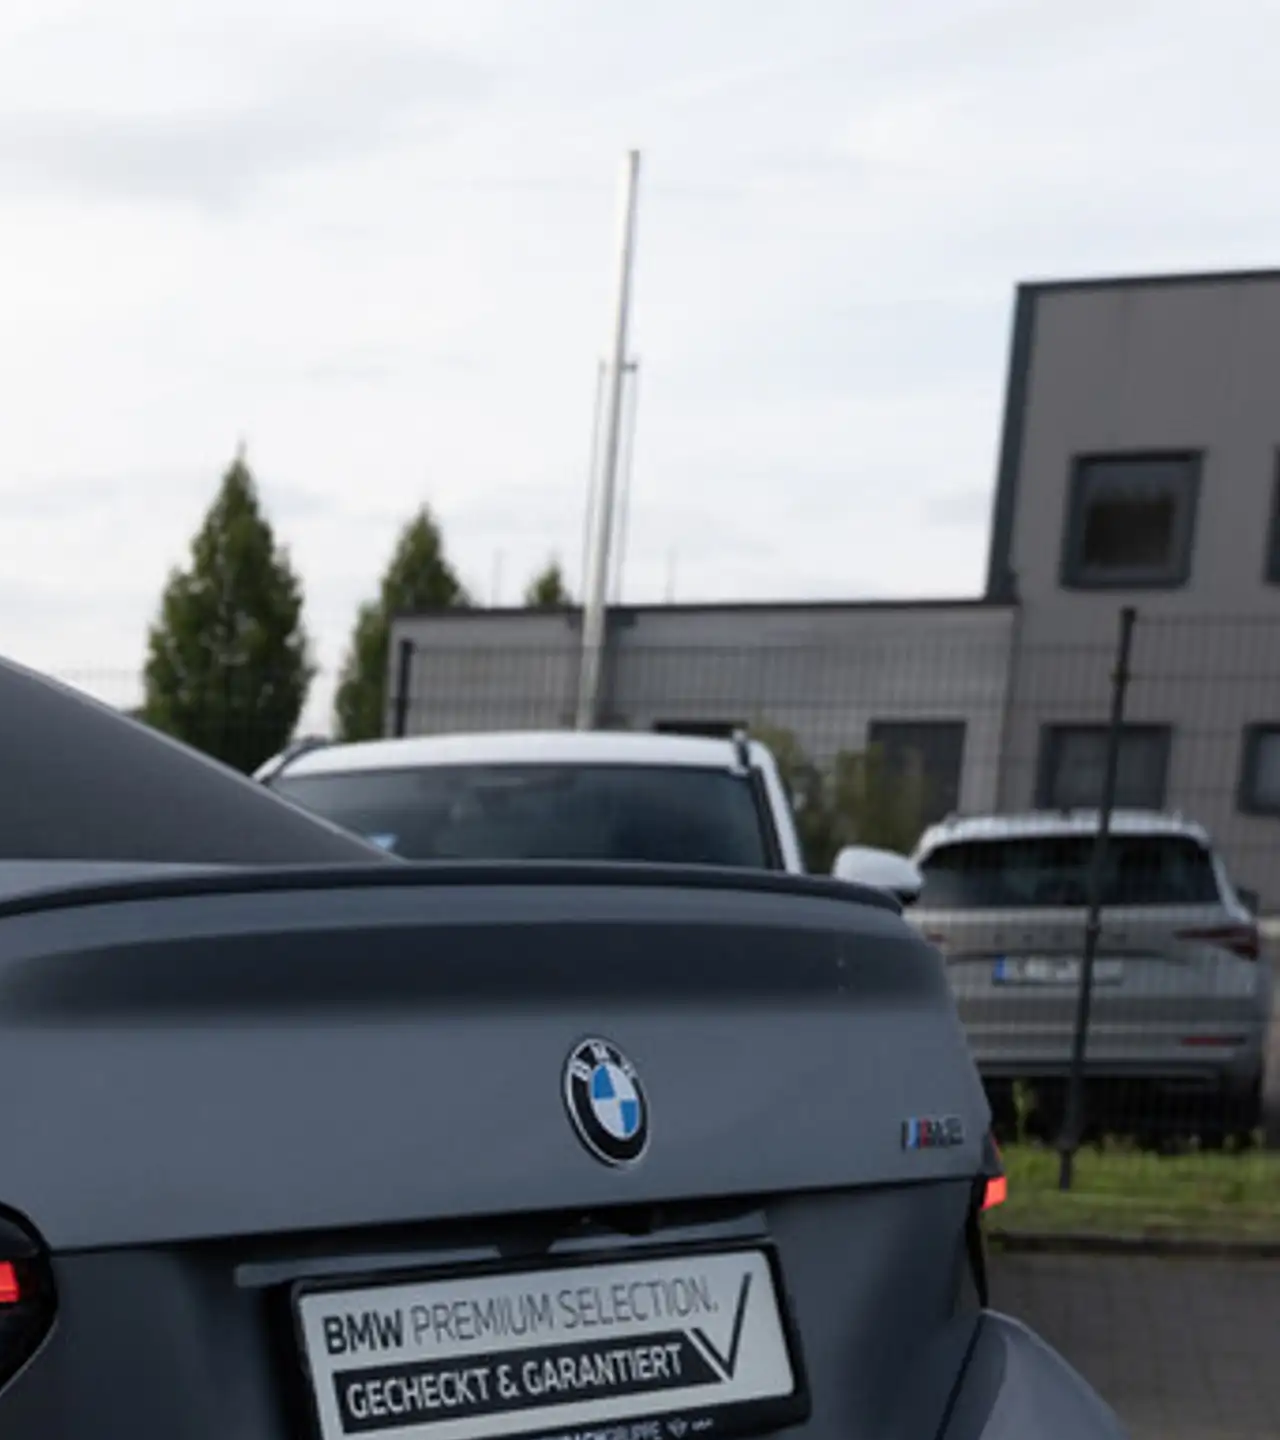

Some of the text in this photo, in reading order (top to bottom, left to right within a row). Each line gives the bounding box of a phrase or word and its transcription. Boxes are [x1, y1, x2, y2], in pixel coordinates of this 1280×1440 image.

[323, 1309, 404, 1355] BMW
[412, 1292, 555, 1345] PREMIUM
[346, 1342, 684, 1420] GECHECKT & GARANTIERT
